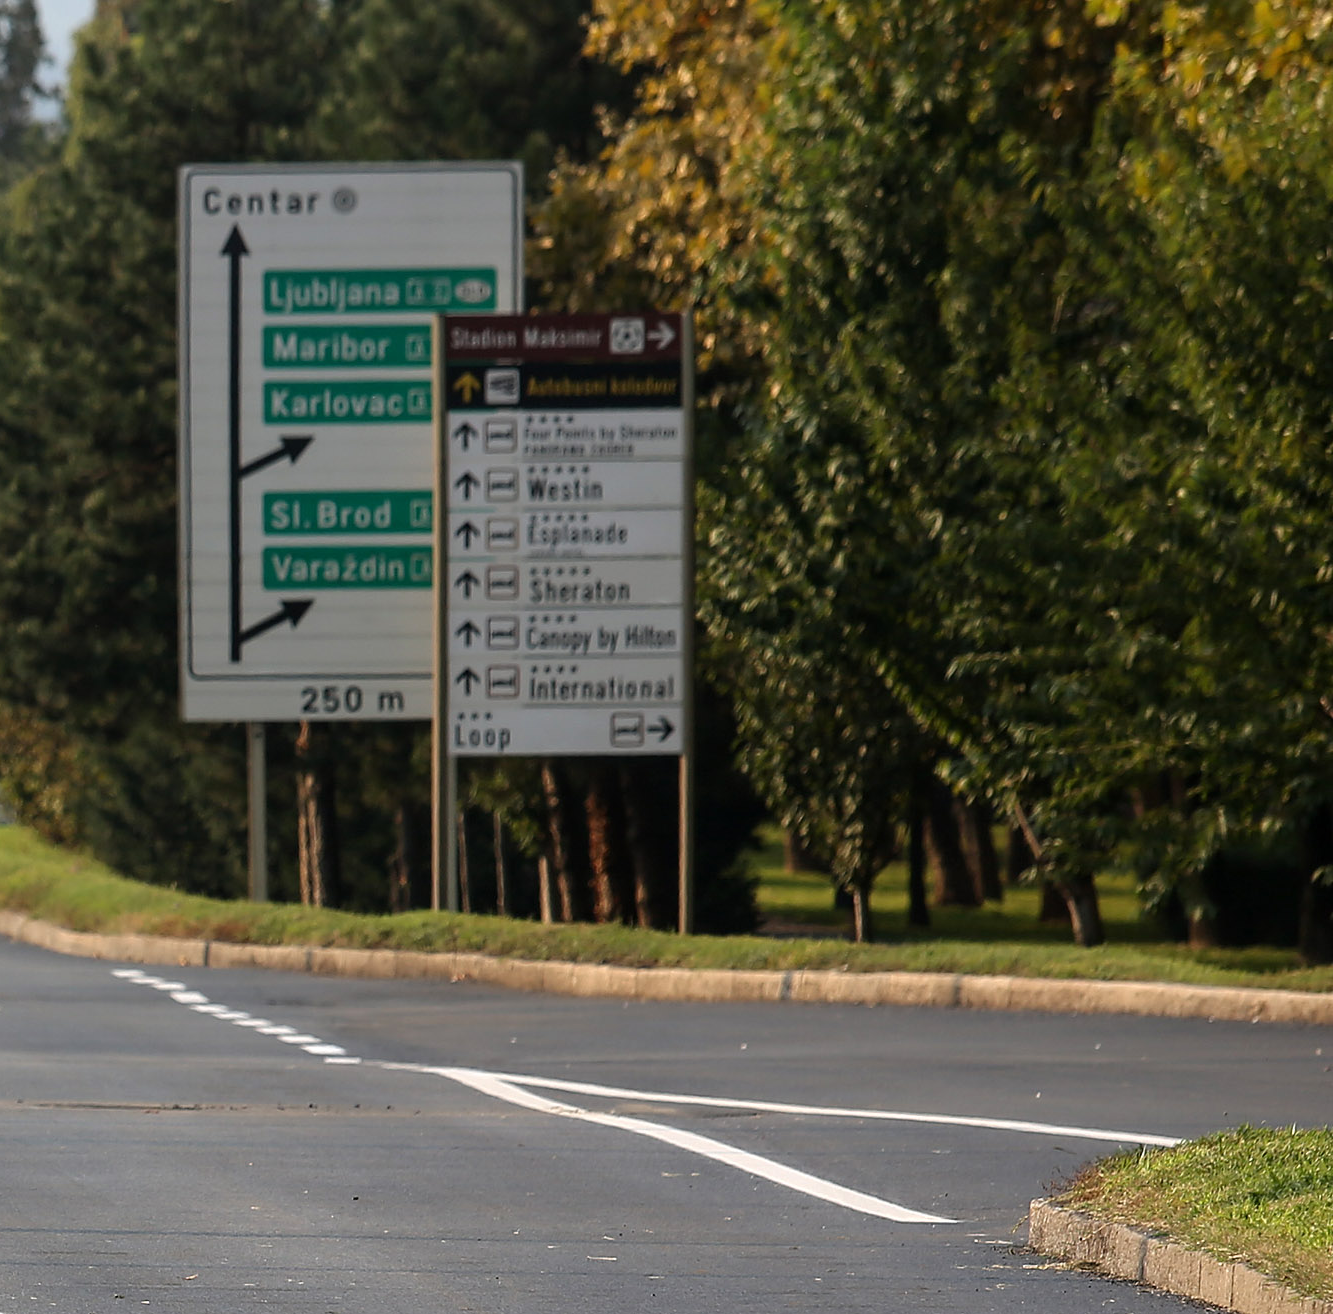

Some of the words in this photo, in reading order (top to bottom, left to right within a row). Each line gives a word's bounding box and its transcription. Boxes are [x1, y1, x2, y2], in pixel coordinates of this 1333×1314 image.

[202, 187, 320, 215] Centar
[269, 277, 400, 313] Ljubljana
[272, 331, 391, 361] Maribor
[450, 327, 517, 349] Stadion
[523, 326, 601, 348] Maksimir
[270, 388, 404, 417] Karlovac
[527, 478, 603, 501] Westin
[270, 500, 311, 530] Sl.
[317, 499, 392, 529] Brod
[527, 522, 628, 550] Esplanade
[271, 552, 405, 582] Varaždin
[529, 578, 631, 602] Sheraton
[526, 627, 591, 655] Canopy
[597, 624, 619, 655] by
[624, 623, 677, 649] Hilton
[301, 684, 364, 714] 250
[378, 690, 405, 712] m
[529, 673, 675, 700] International
[454, 724, 511, 751] Loop
